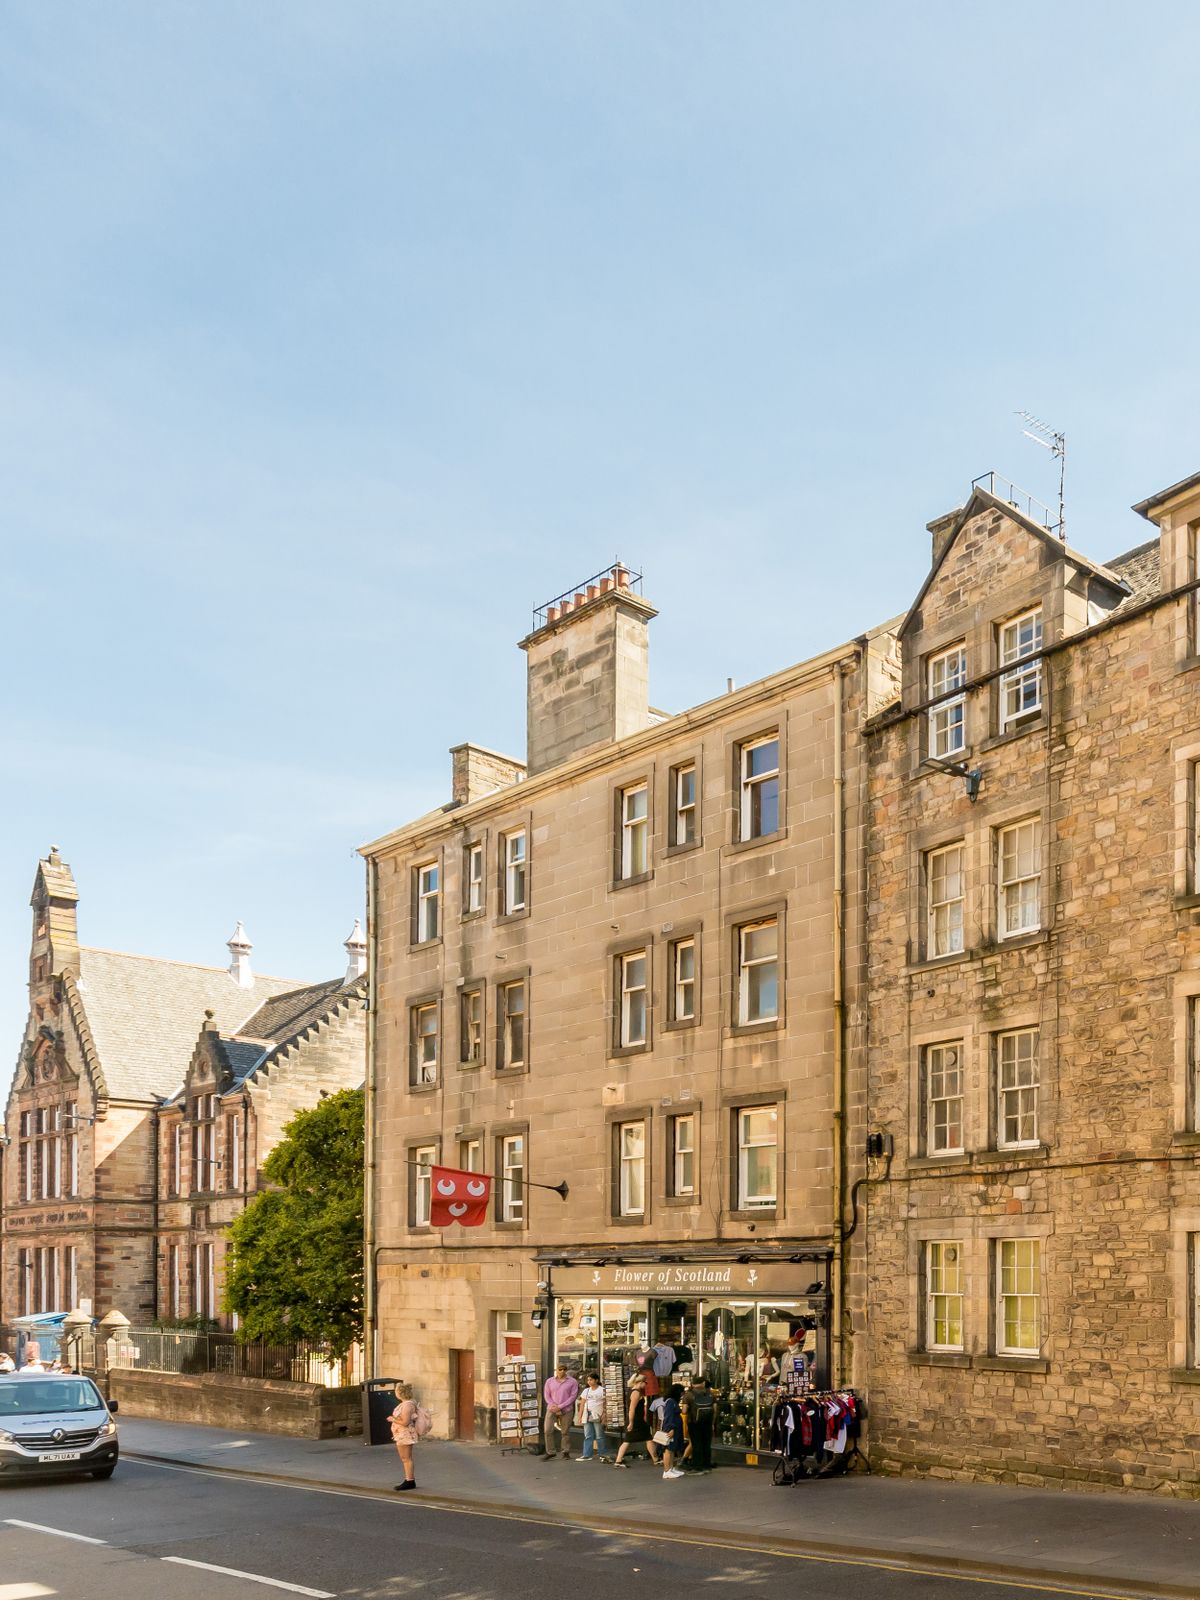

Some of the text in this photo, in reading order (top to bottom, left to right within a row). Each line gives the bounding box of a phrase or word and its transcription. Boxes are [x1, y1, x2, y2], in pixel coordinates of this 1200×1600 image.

[614, 1267, 731, 1285] Flower of Scotland
